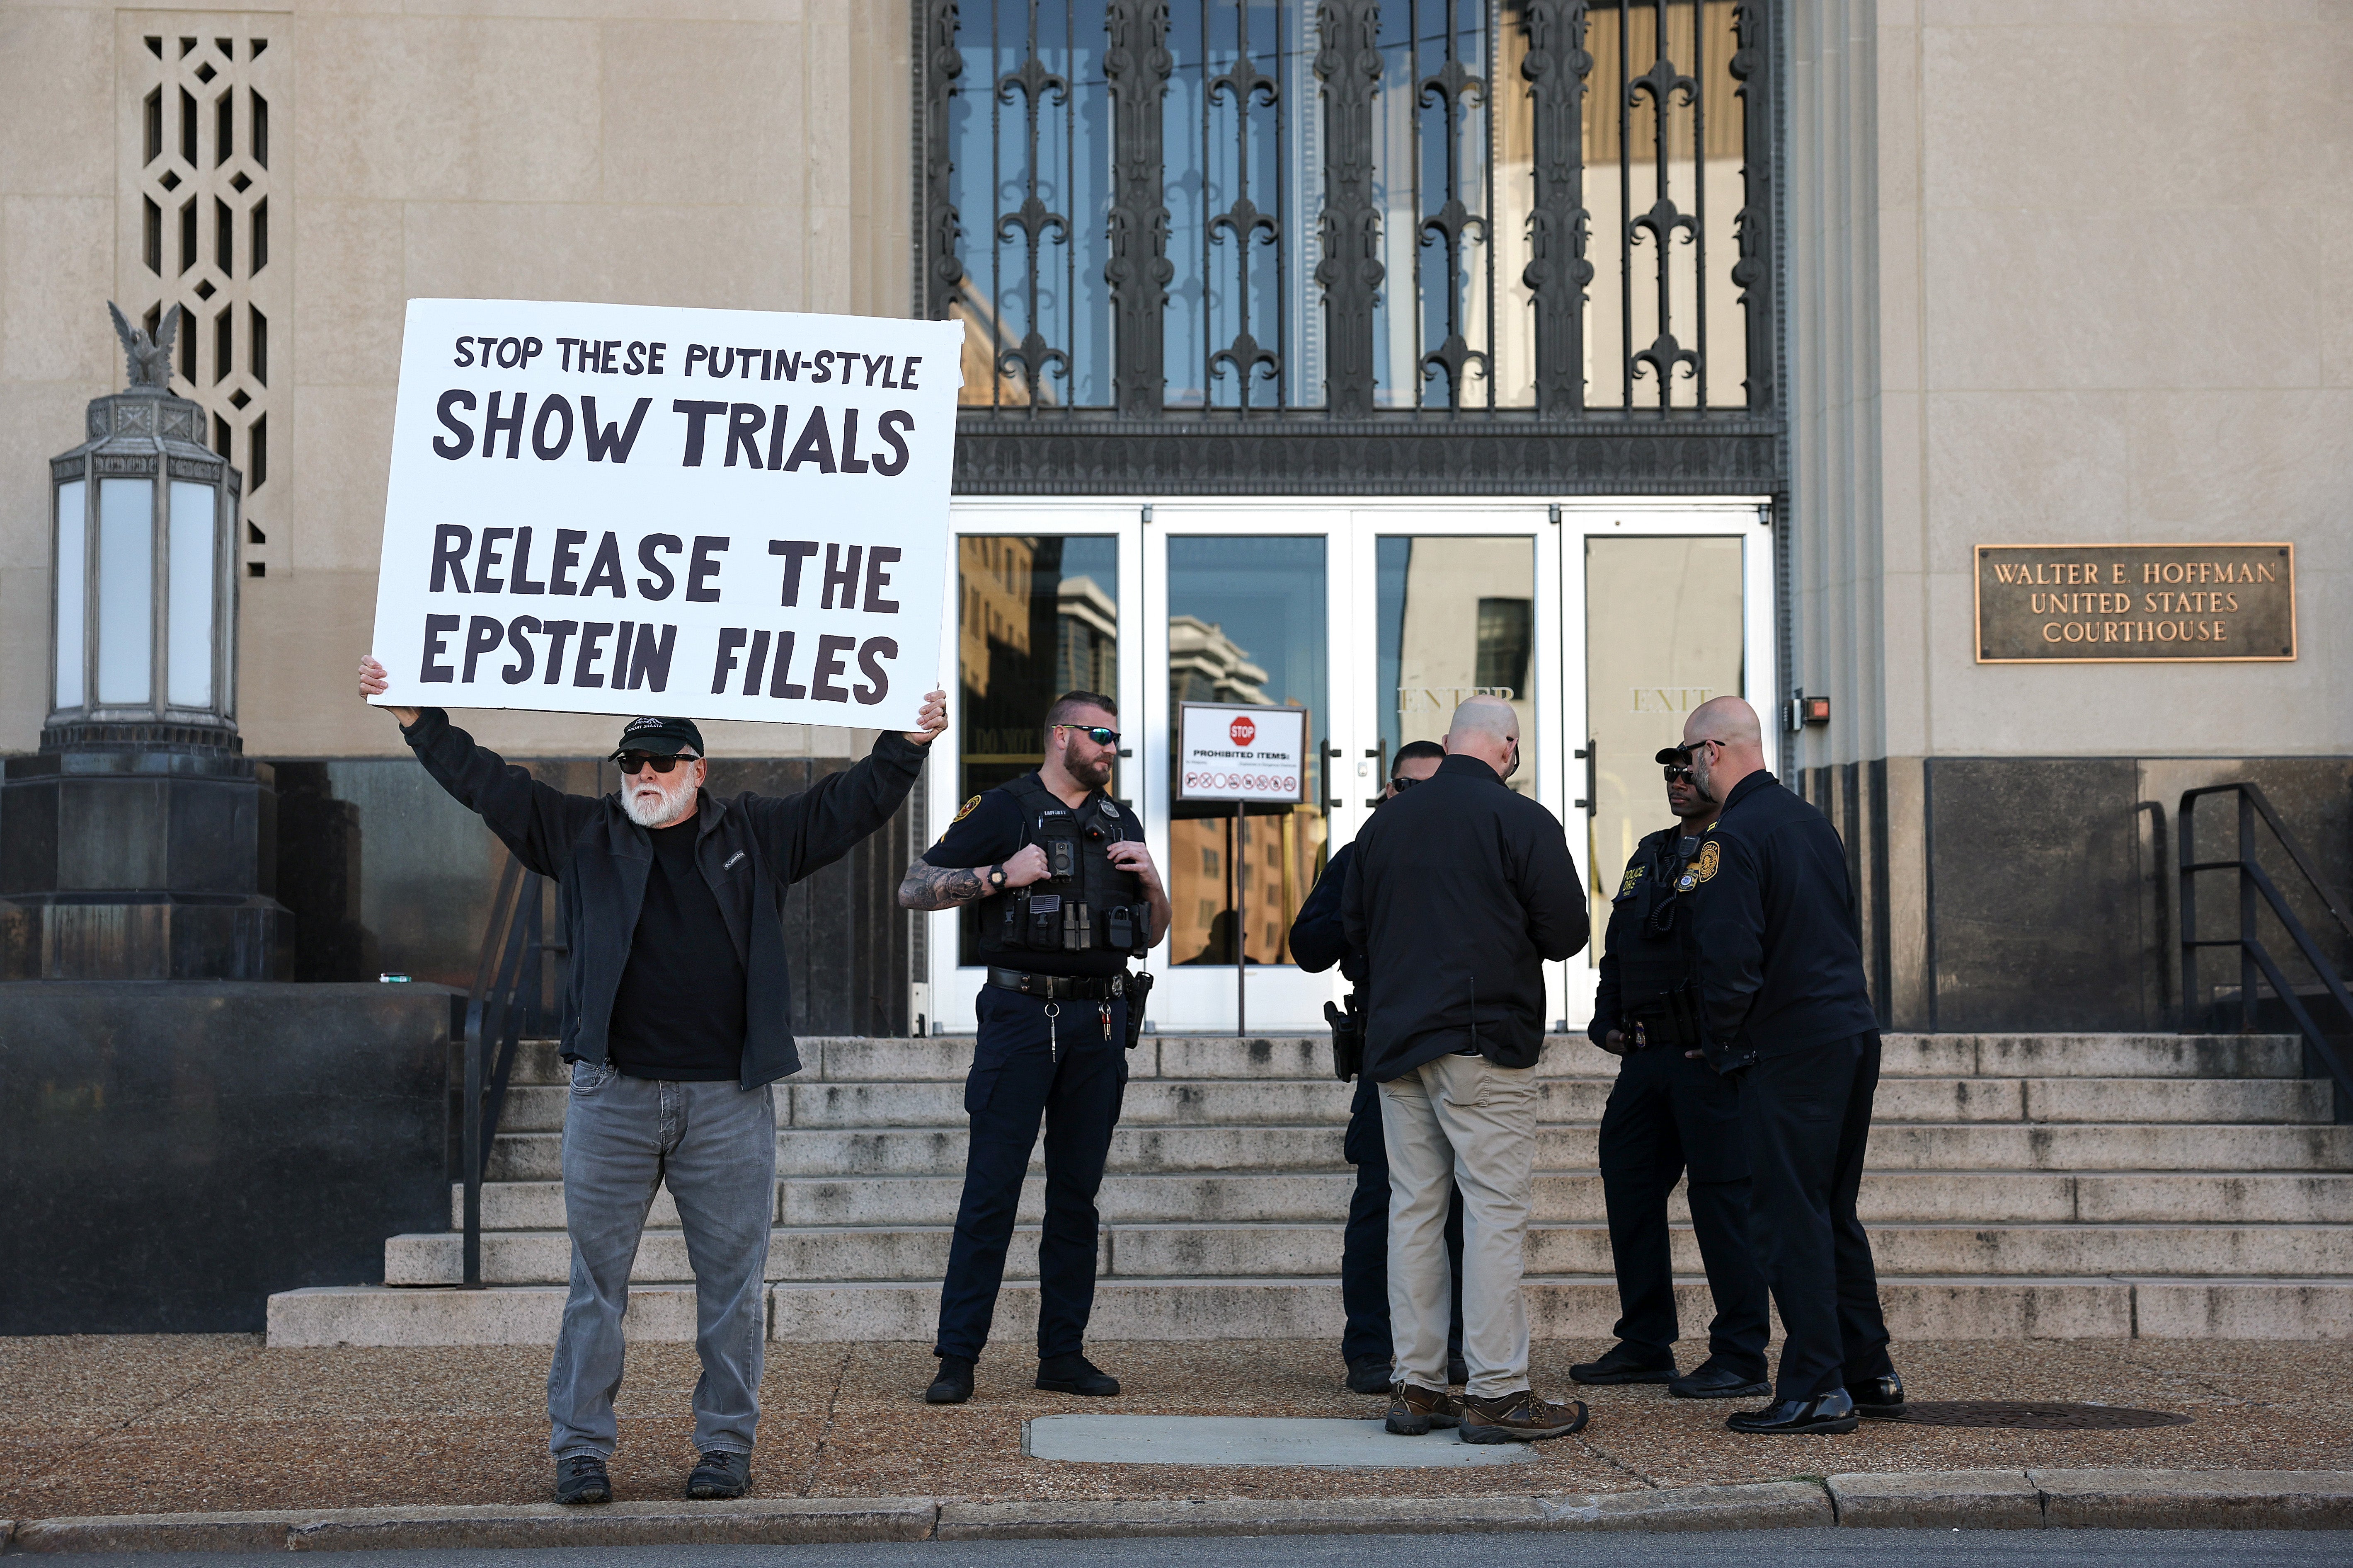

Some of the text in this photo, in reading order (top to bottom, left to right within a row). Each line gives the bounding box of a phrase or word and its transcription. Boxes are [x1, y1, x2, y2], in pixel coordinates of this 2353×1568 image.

[454, 336, 923, 390] STOP THESE PUTIN-STYLE
[433, 389, 915, 477] SHOW TRIALS
[429, 523, 901, 614] RELEASE THE
[1993, 561, 2276, 585] WALTER E. HOFFMAN
[2030, 591, 2239, 615] UNITED STATES
[2042, 619, 2228, 643] COURTHOUSE
[420, 613, 899, 705] EPSTEIN FILES
[1629, 687, 1714, 714] EXIT
[1231, 725, 1254, 738] STOP
[1193, 749, 1289, 760] PROHIBITED ITEMS:
[728, 852, 744, 865] Columbia
[1624, 866, 1645, 880] POLICE
